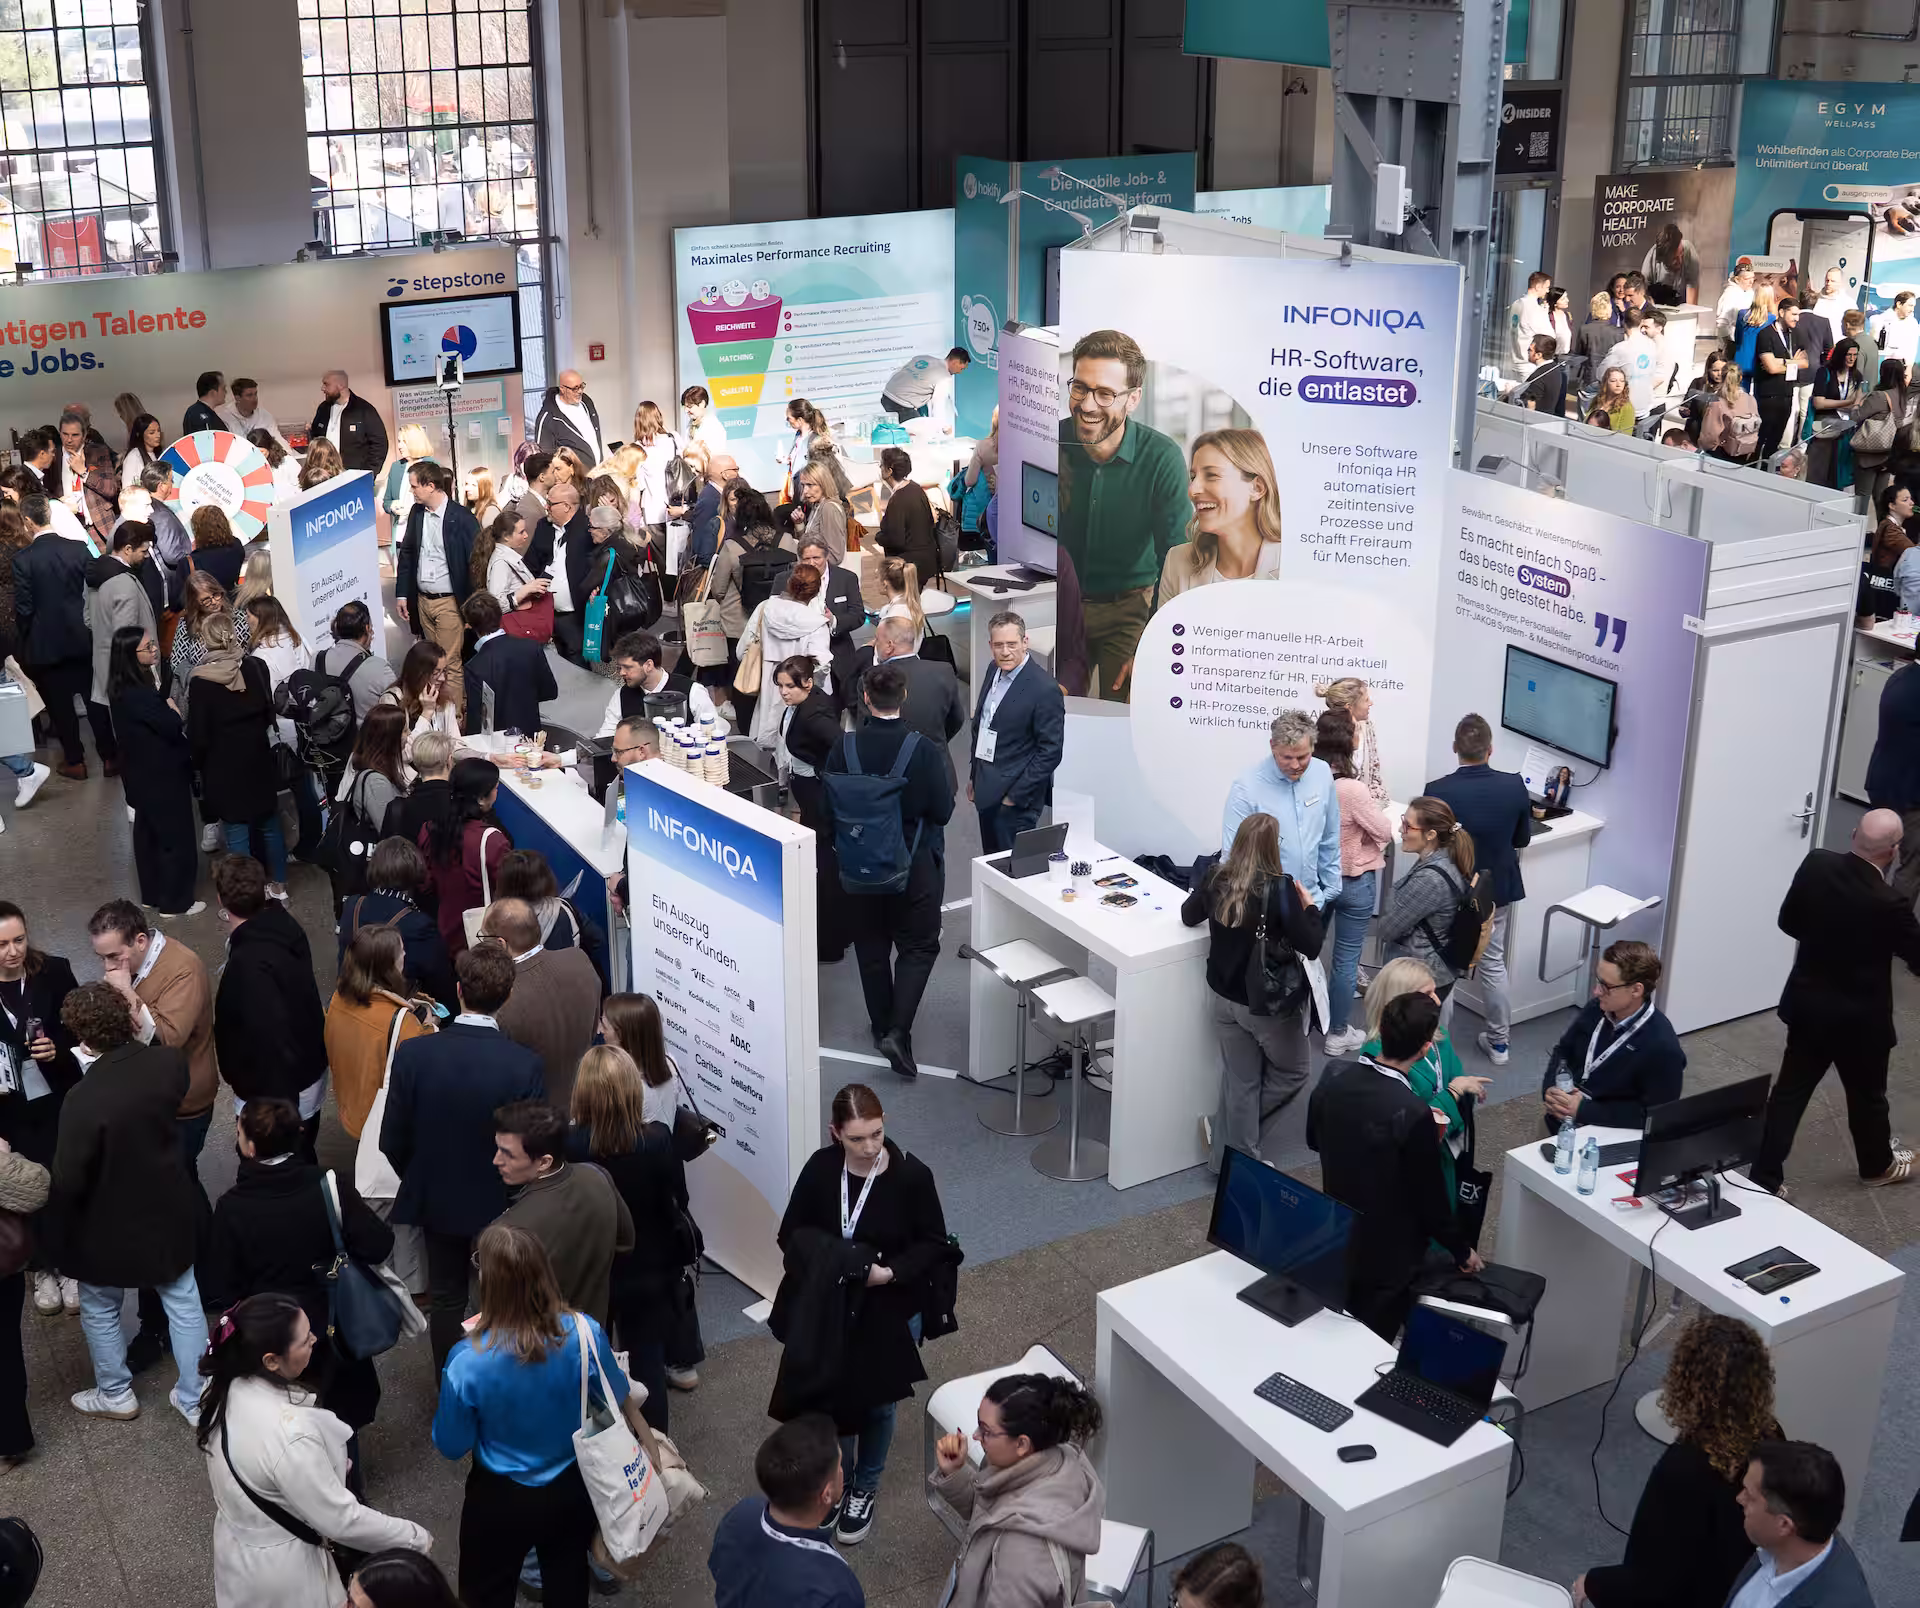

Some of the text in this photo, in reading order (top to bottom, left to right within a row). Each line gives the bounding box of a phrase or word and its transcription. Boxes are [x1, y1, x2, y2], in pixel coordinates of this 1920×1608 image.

[1516, 108, 1552, 119] INSIDER
[1824, 120, 1876, 128] WELLPASS
[1757, 144, 1828, 156] Wohlbefinden
[1831, 147, 1845, 156] als
[1848, 147, 1899, 159] Corporate
[1756, 158, 1830, 169] Unlimitiert und
[1051, 171, 1167, 191] Die mobile Job- &
[978, 180, 1001, 202] hokify
[1605, 184, 1639, 199] MAKE
[1044, 194, 1112, 212] Candidate
[1604, 198, 1675, 215] CORPORATE
[1603, 216, 1647, 231] HEALTH
[1602, 232, 1637, 247] WORK
[691, 242, 891, 266] Maximales Performance Recruiting
[413, 272, 505, 292] stepstone
[0, 307, 207, 349] tigen Talente
[715, 322, 756, 332] REICHWEITE
[973, 320, 990, 332] 750+
[1284, 305, 1425, 334] INFONIQA
[22, 348, 104, 376] Jobs.
[719, 354, 754, 362] MATCHING
[1271, 348, 1423, 377] HR-Software,
[1008, 359, 1056, 382] Alles aus einer
[413, 389, 444, 397] wünsche
[1008, 376, 1059, 400] HR, Payroll, Fina
[1258, 377, 1292, 396] die
[400, 410, 434, 418] Recruiting
[444, 405, 483, 414] eeichtern?
[1008, 393, 1059, 419] und Outsourcing
[1302, 442, 1417, 460] Unsere Software
[1338, 462, 1416, 479] Infoniqa HR
[204, 473, 216, 484] Hier
[217, 484, 233, 497] dreht
[1324, 481, 1415, 496] automatisiert
[208, 486, 222, 498] alles
[222, 496, 232, 505] um
[1328, 498, 1414, 514] zeitintensive
[306, 497, 364, 538] INFONIQA
[1320, 515, 1413, 531] Prozesse und
[1300, 532, 1412, 549] schafft Freiraum
[1536, 528, 1602, 556] Weiterempfohlen.
[1313, 550, 1410, 567] für Menschen.
[1459, 549, 1480, 566] das
[1482, 554, 1515, 578] beste
[1460, 527, 1474, 542] Es
[1476, 533, 1514, 556] macht
[1516, 546, 1560, 571] einfach
[1564, 560, 1596, 581] Spaß
[311, 569, 343, 593] Ein Auszug
[1870, 575, 1894, 590] HRE
[312, 575, 359, 607] unserer Kunden.
[1458, 569, 1586, 624] das ich getestet habe.
[1457, 594, 1572, 641] Thomas Schreyer, Personalleiter
[1193, 626, 1363, 648] Weniger manuelle HR-Arbeit
[1456, 606, 1619, 672] OTT-JAKOB System- & Maschinenproduktion
[1192, 645, 1387, 669] Informationen zentral und aktuell
[1192, 664, 1308, 684] Transparenz für HR,
[1190, 682, 1298, 698] und Mitarbeitende
[1190, 700, 1269, 716] HR-Prozesse,
[1189, 716, 1270, 730] wirklich funkti
[648, 807, 758, 882] INFONIQA
[653, 894, 709, 939] Ein Auszug
[653, 916, 740, 973] unserer Kunden.
[655, 948, 673, 964] Allianz
[694, 969, 706, 984] VIE
[667, 1018, 687, 1036] BOSCH
[702, 1040, 725, 1058] COFFEMA
[730, 1033, 751, 1054] ADAC
[695, 1054, 723, 1078] Caritas
[738, 1062, 765, 1081] INTERSPORT
[697, 1074, 722, 1092] Panasonic
[731, 1076, 763, 1102] bellaflora
[1460, 1181, 1482, 1199] EX
